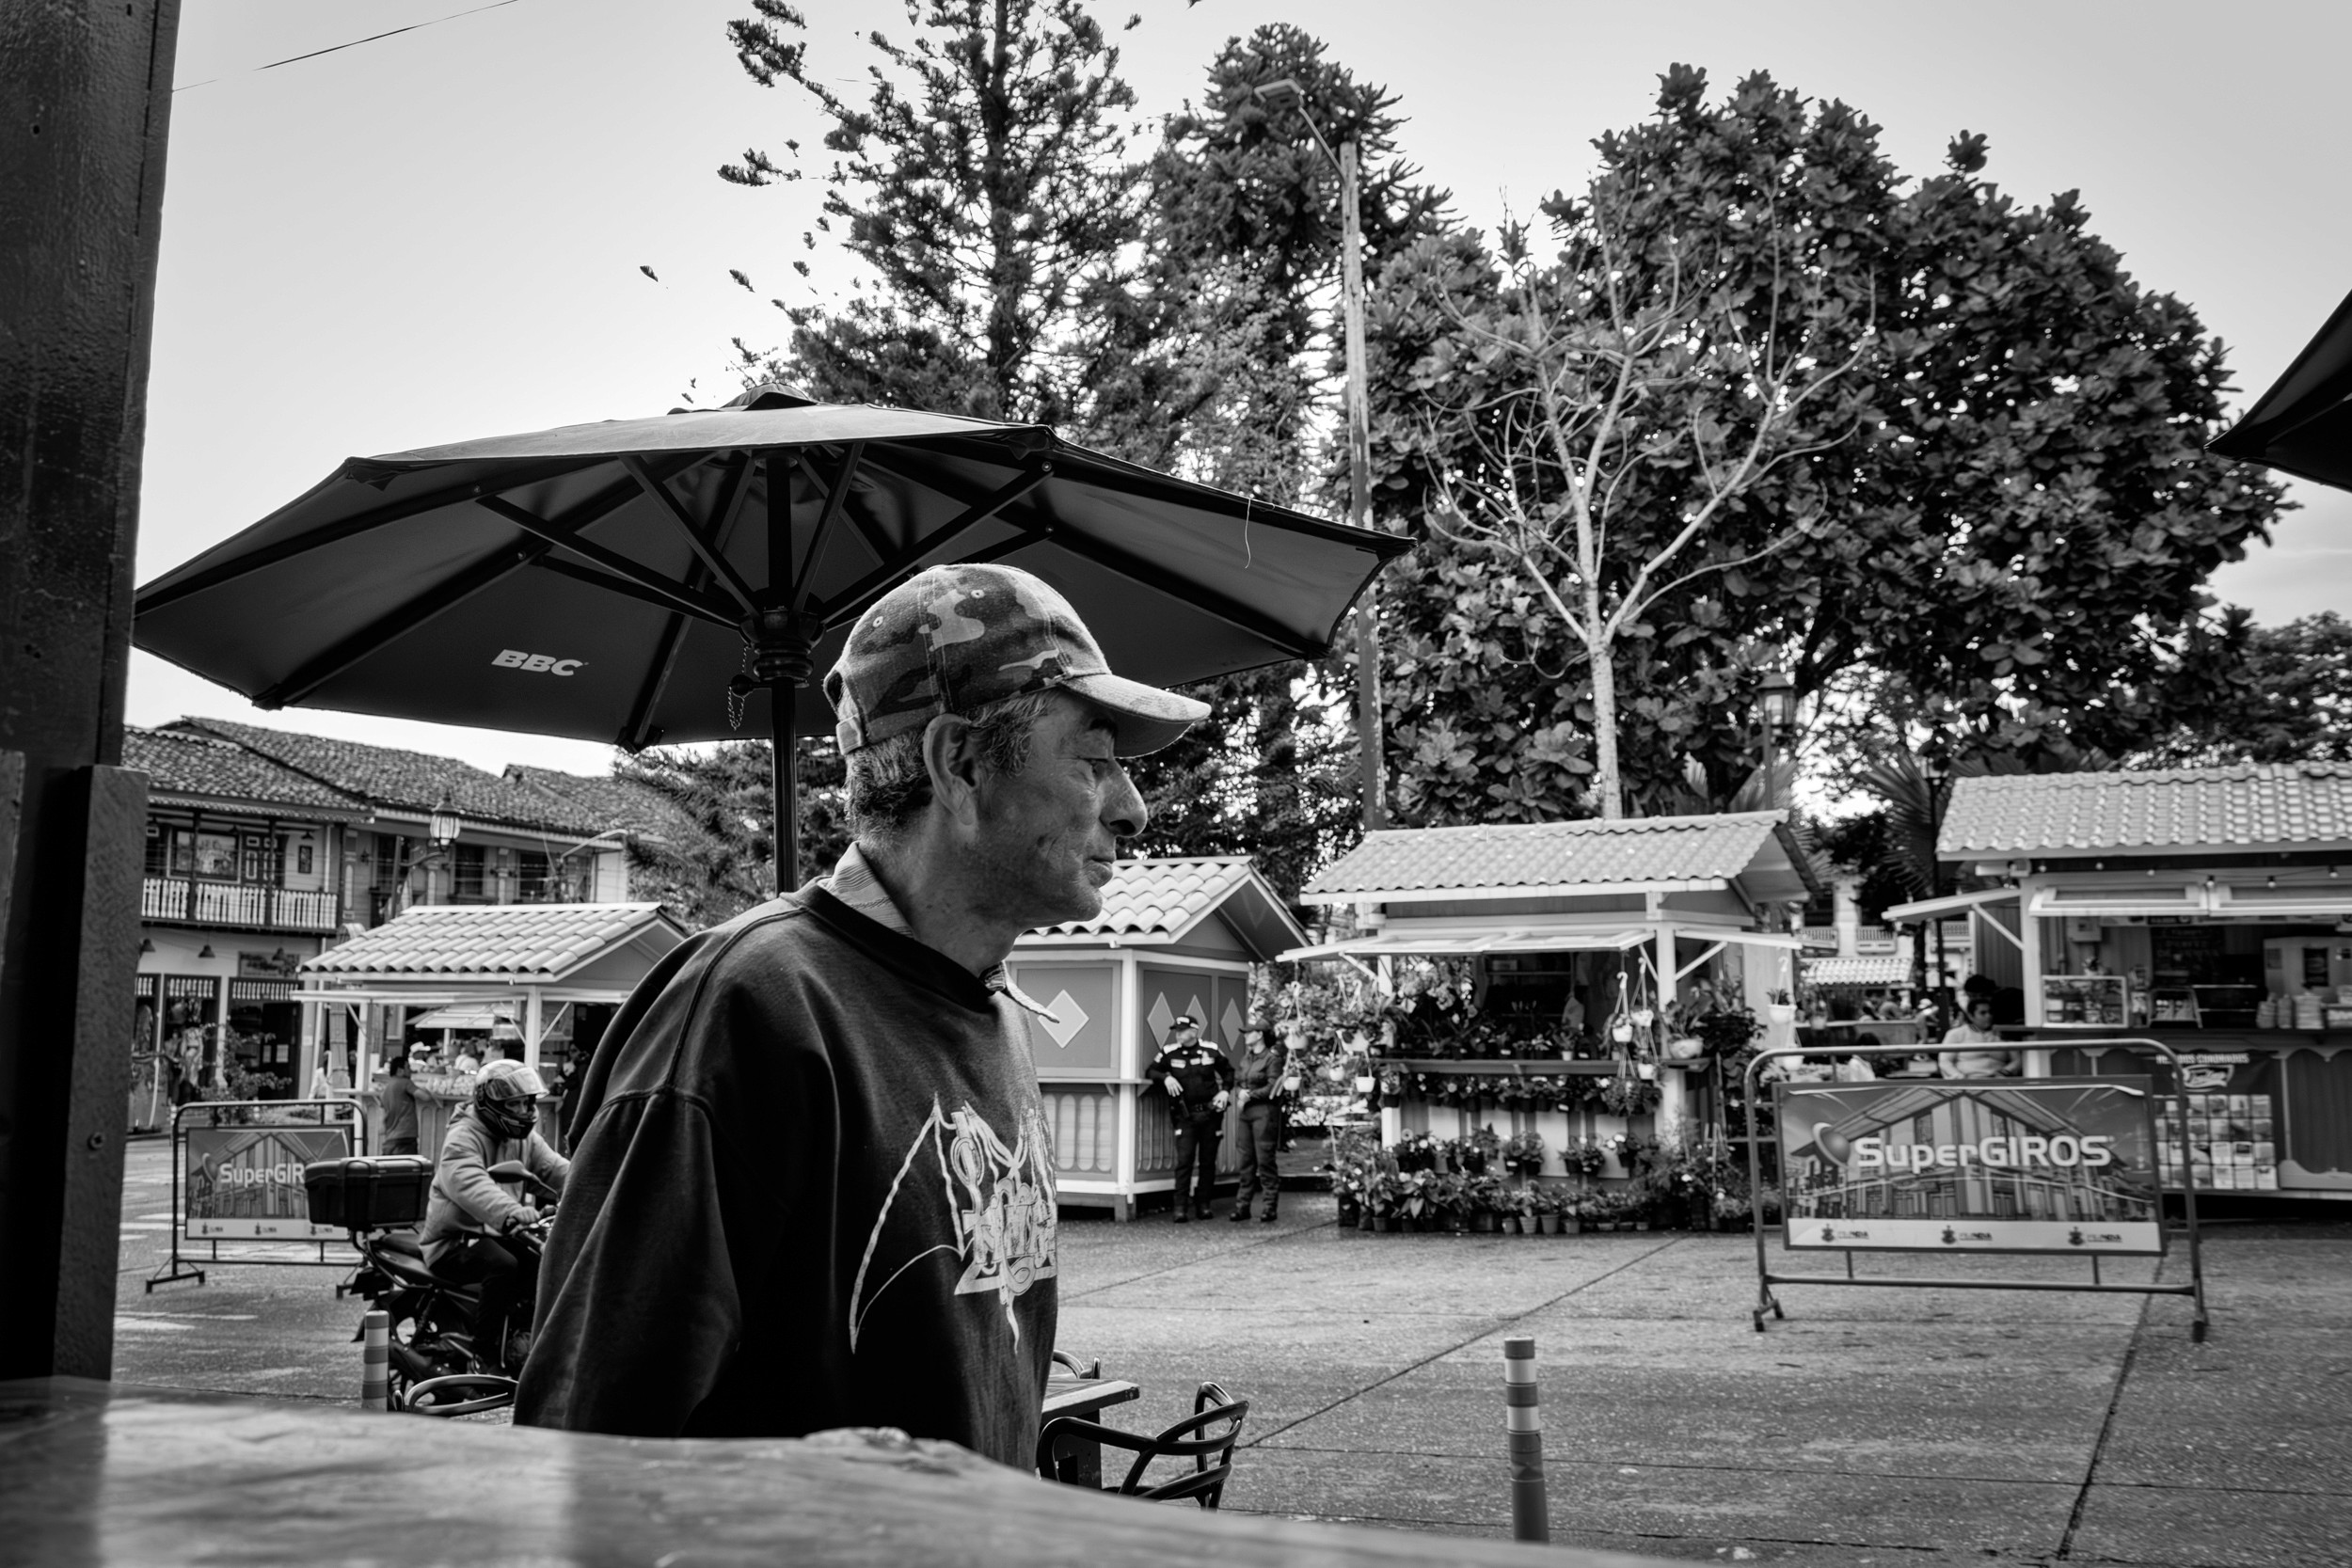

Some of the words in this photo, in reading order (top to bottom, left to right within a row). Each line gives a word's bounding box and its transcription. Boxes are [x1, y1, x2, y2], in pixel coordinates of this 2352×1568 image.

[491, 649, 583, 676] BBC
[1854, 1135, 2112, 1174] SuperGIROS
[219, 1163, 306, 1188] SuperGIR
